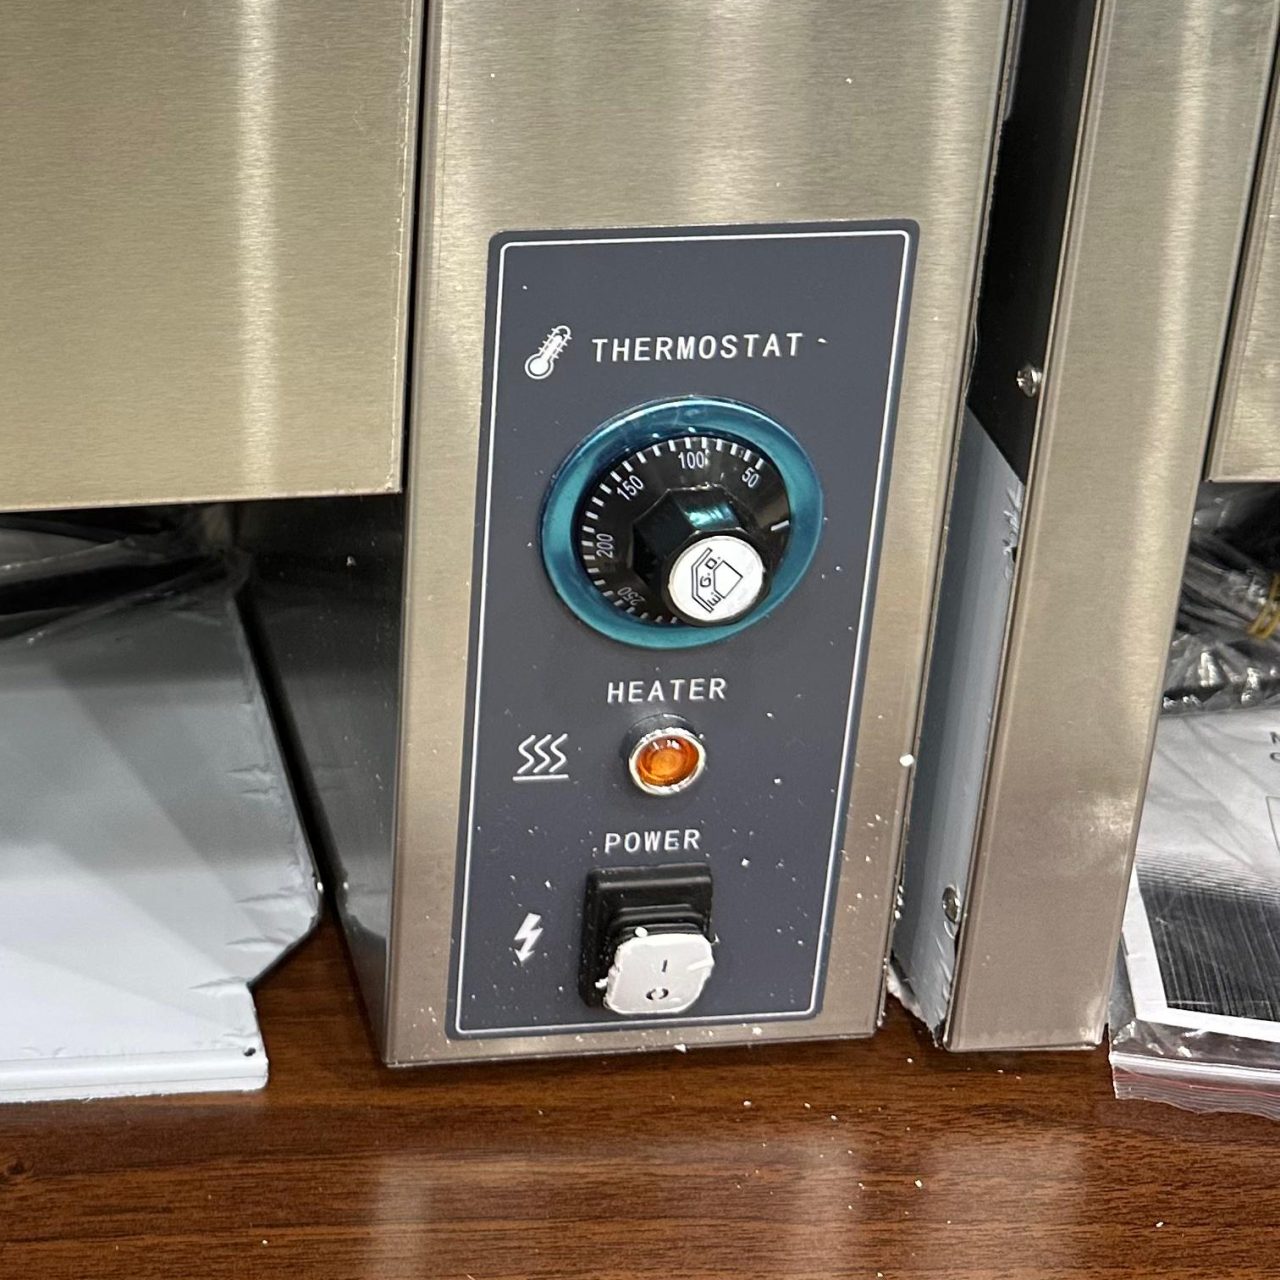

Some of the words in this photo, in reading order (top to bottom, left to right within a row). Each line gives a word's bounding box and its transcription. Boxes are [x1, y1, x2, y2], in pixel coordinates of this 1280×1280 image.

[591, 332, 804, 363] THERMOSTAT
[678, 451, 705, 469] 100
[616, 475, 644, 501] 150
[741, 467, 760, 488] 50
[596, 533, 614, 559] 200
[618, 586, 646, 606] 250
[606, 677, 728, 704] HEATER
[604, 828, 703, 854] POWER
